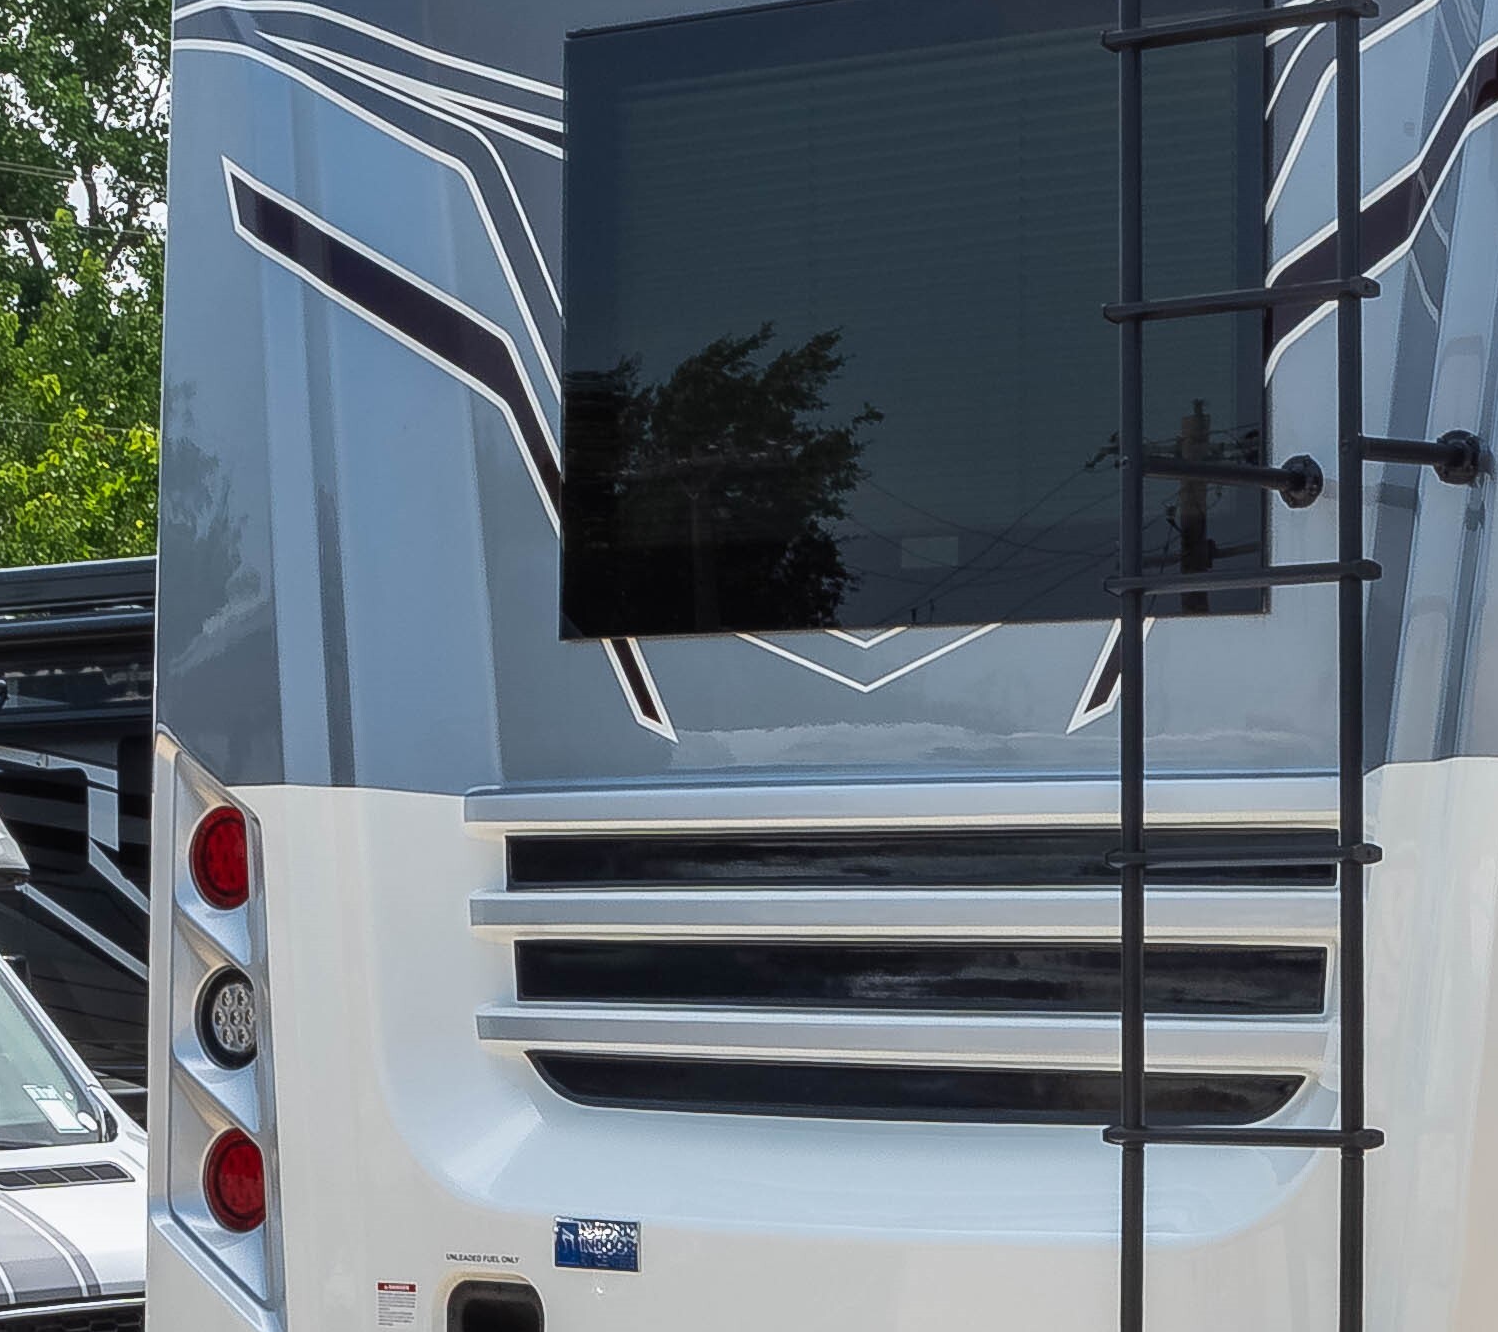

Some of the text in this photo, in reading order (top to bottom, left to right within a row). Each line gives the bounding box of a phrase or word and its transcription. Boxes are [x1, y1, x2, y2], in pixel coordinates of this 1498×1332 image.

[445, 1253, 520, 1264] UNLEADED FUEL ONLY
